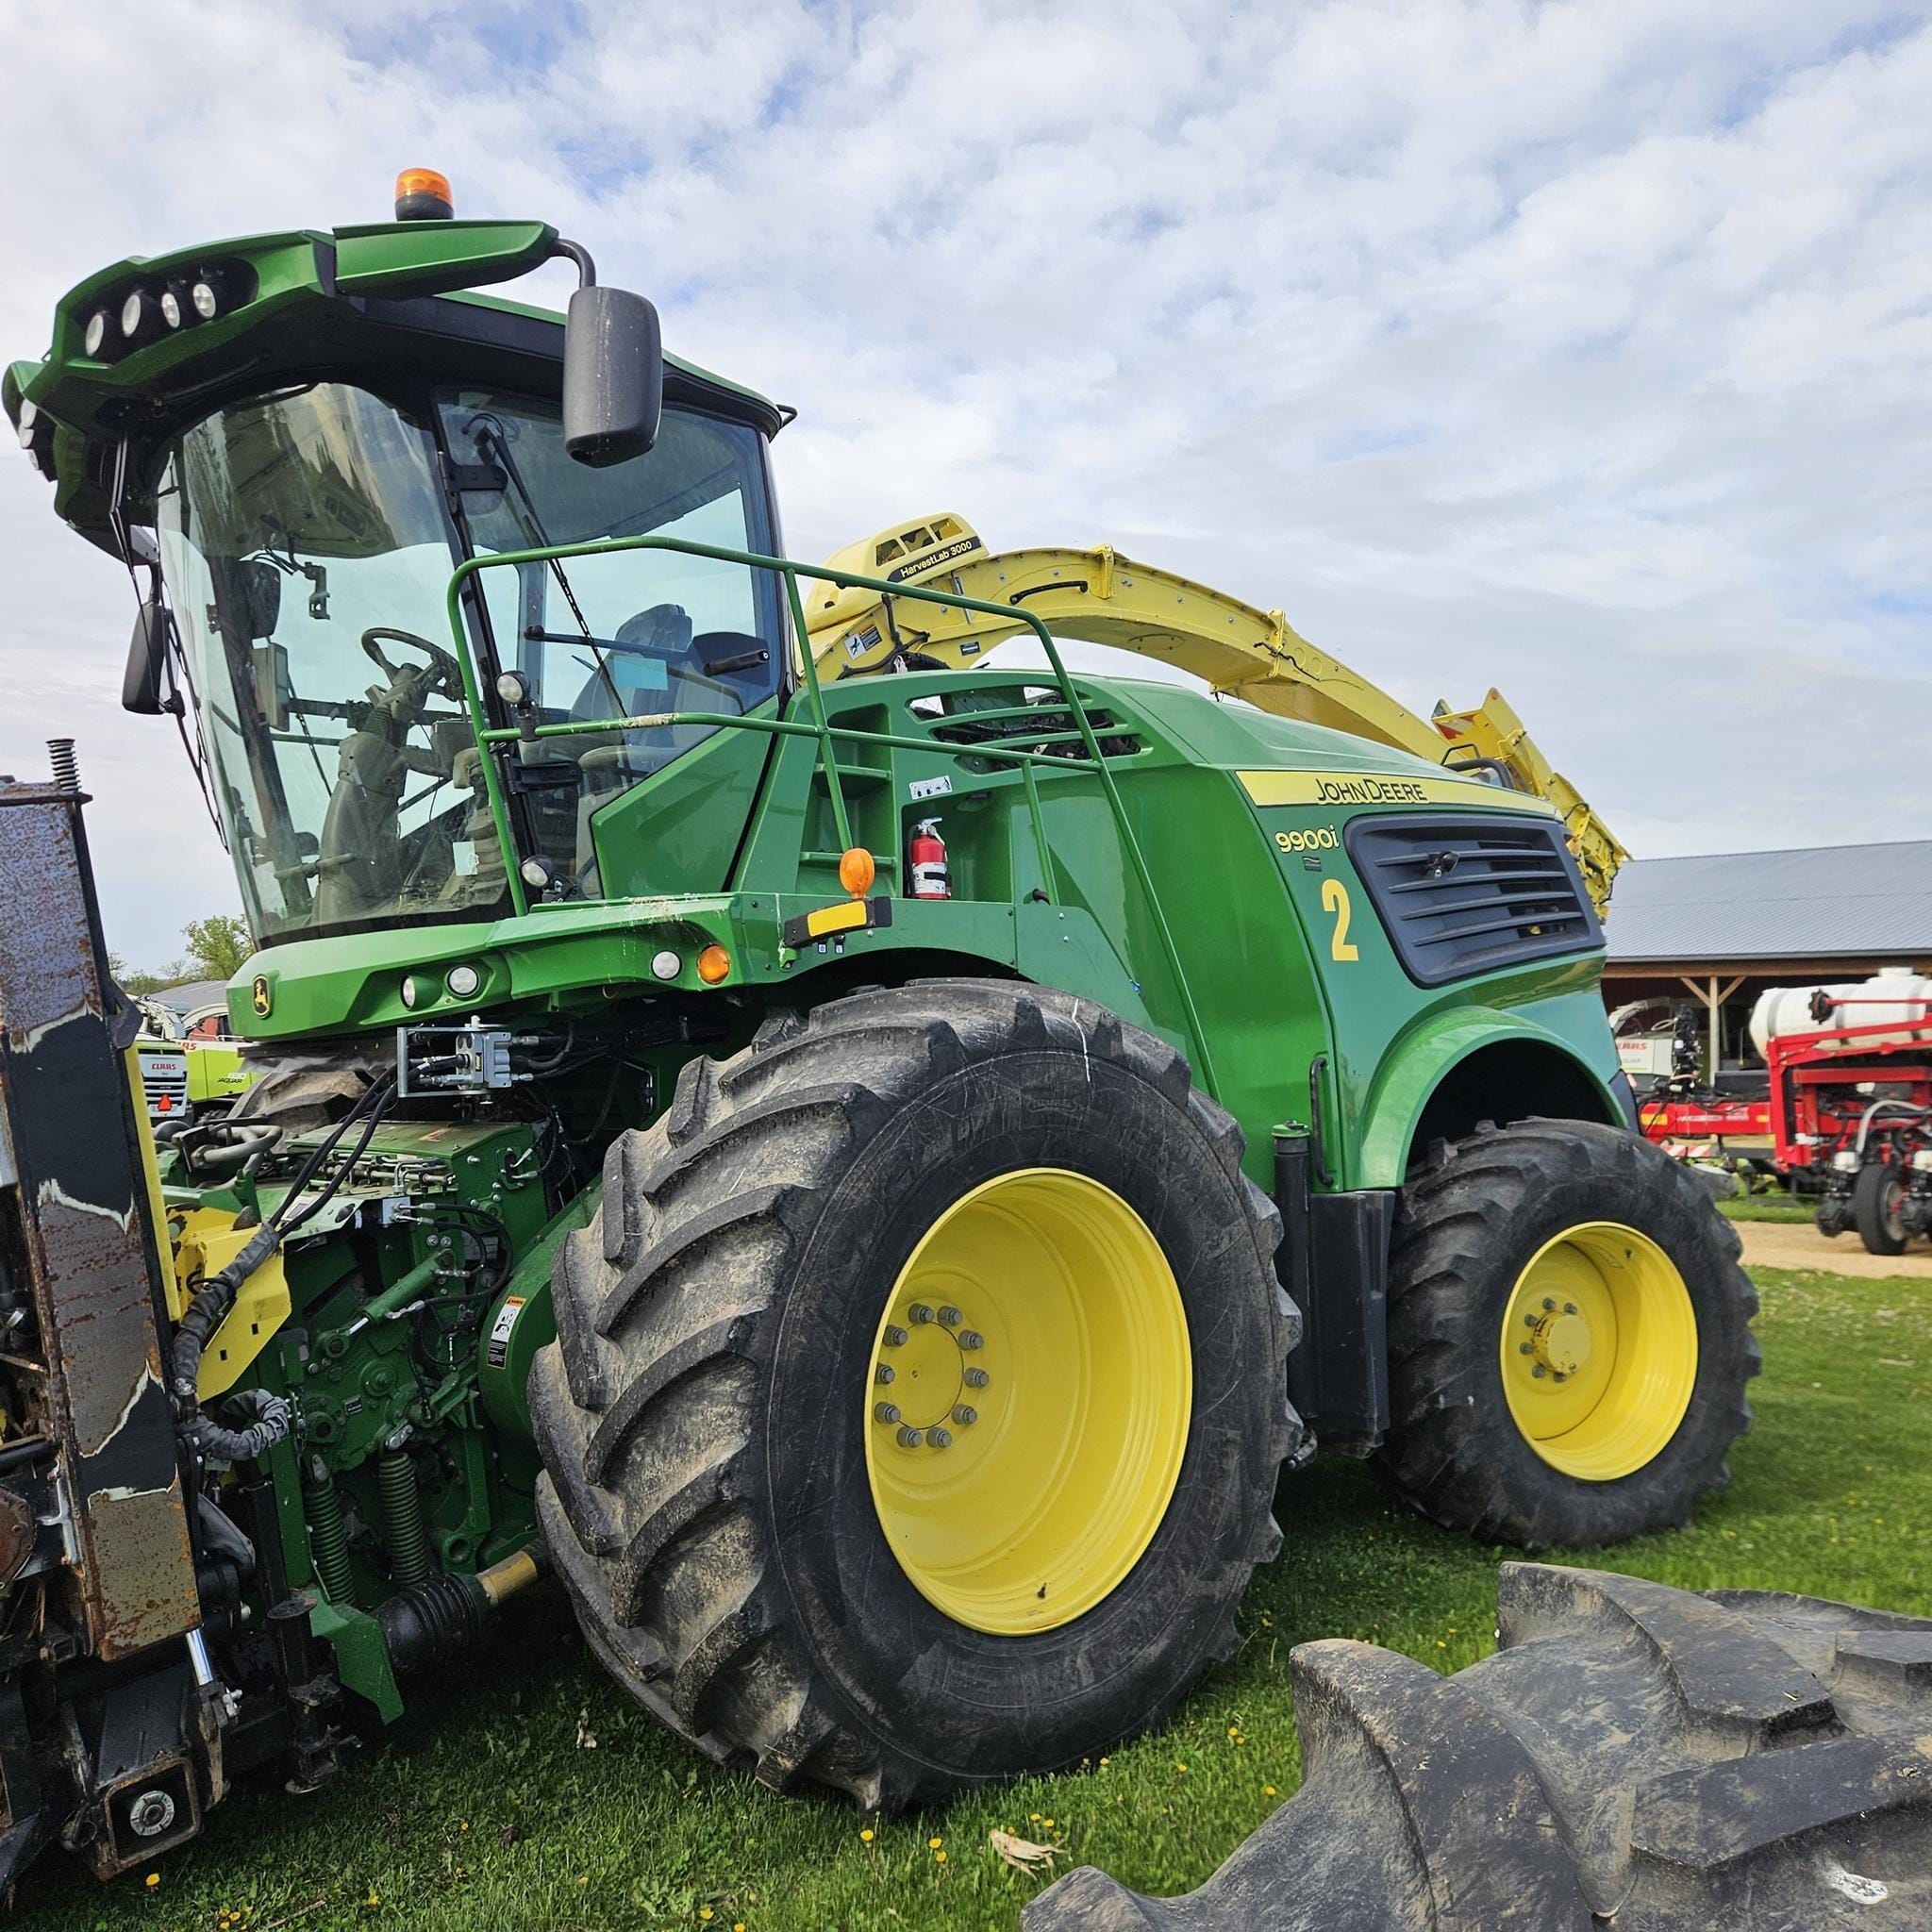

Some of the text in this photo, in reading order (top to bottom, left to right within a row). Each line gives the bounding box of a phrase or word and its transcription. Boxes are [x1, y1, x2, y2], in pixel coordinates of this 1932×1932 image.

[900, 541, 973, 578] HarvestLab 3000
[1274, 824, 1341, 853] 9900i
[1322, 878, 1358, 961] 2
